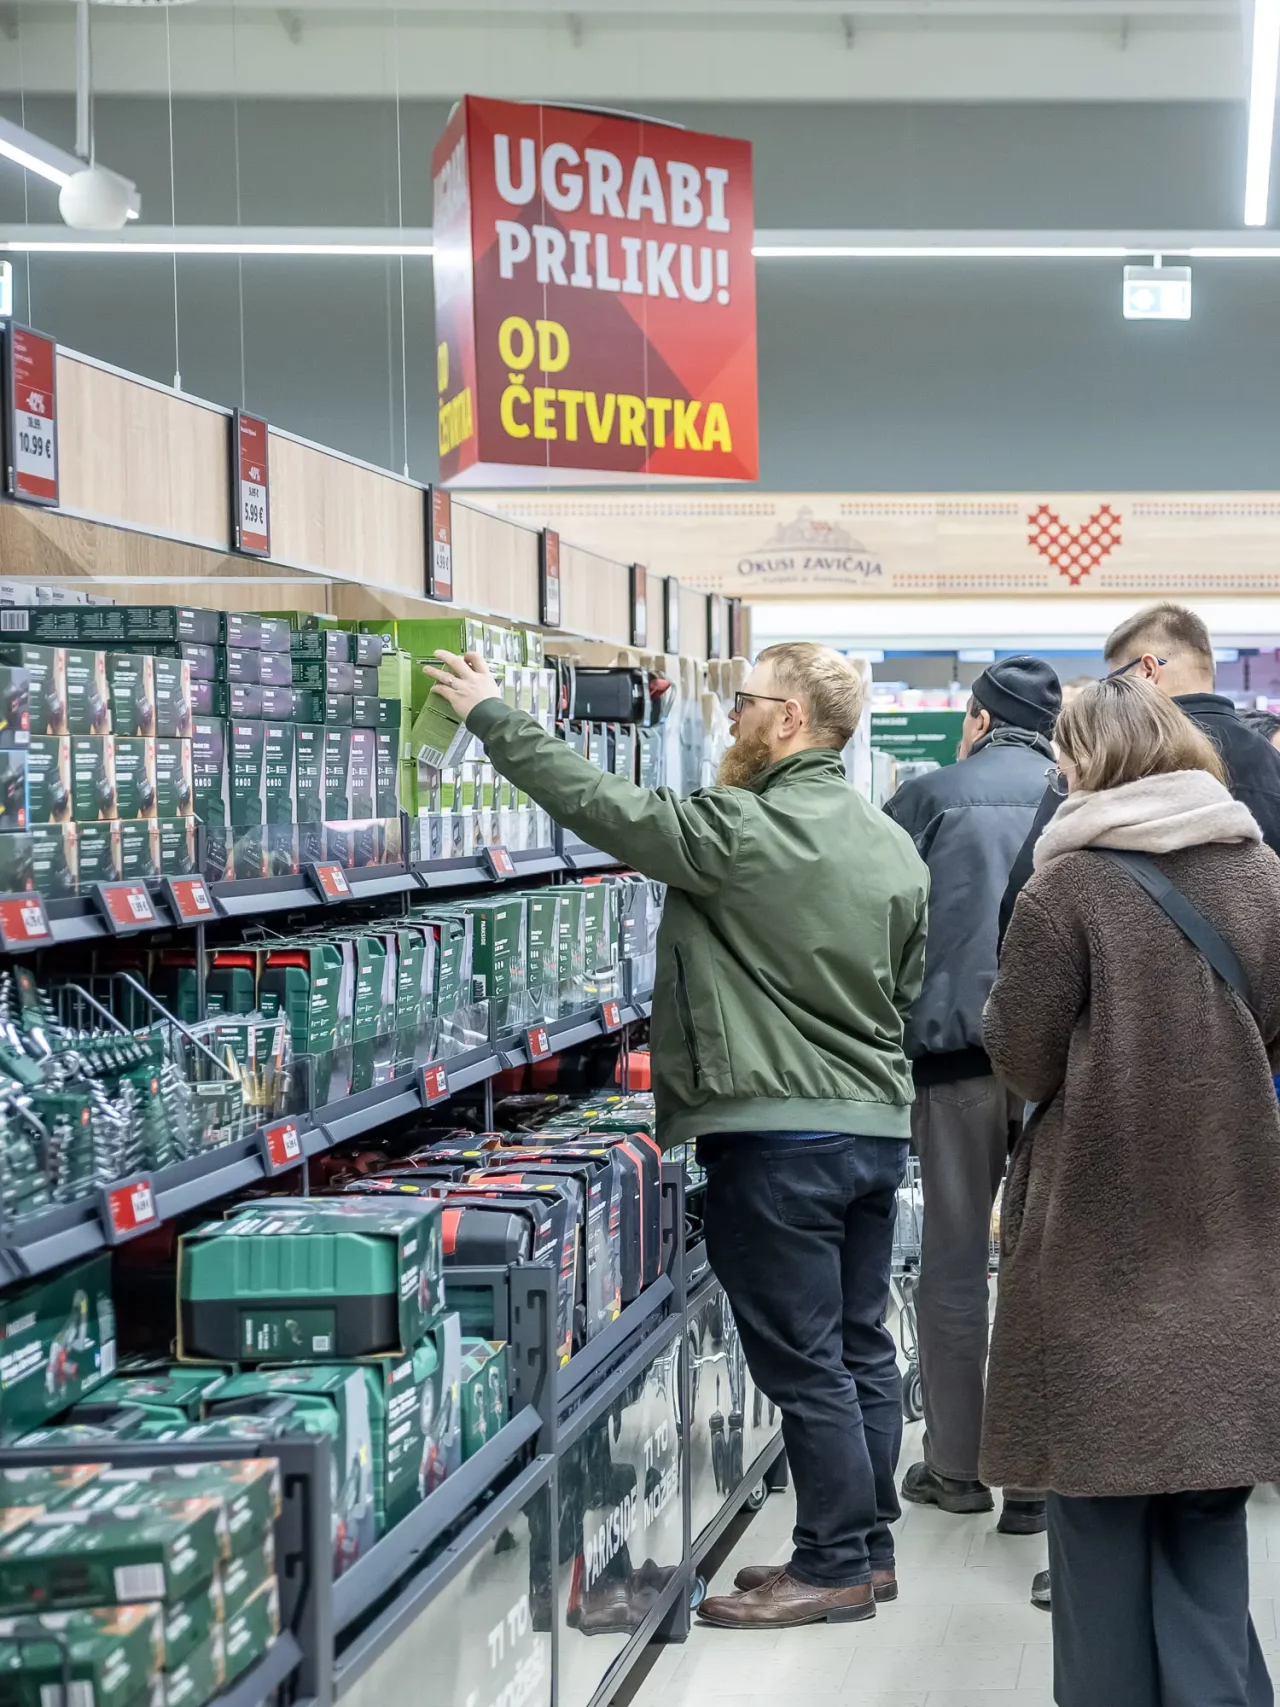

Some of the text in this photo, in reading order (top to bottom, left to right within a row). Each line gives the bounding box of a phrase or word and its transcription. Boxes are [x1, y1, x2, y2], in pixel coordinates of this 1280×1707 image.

[494, 133, 731, 233] UGRABI
[496, 219, 731, 306] PRILIKU!
[498, 315, 571, 373] OD
[19, 432, 52, 459] 10.99 €
[499, 372, 733, 453] ČETVRTKA
[244, 502, 264, 525] 5.99 €
[643, 1419, 668, 1471] TI TO
[643, 1456, 678, 1531] MOŽEŠ
[585, 1484, 638, 1592] PARKSIDE
[488, 1594, 528, 1670] TI TO
